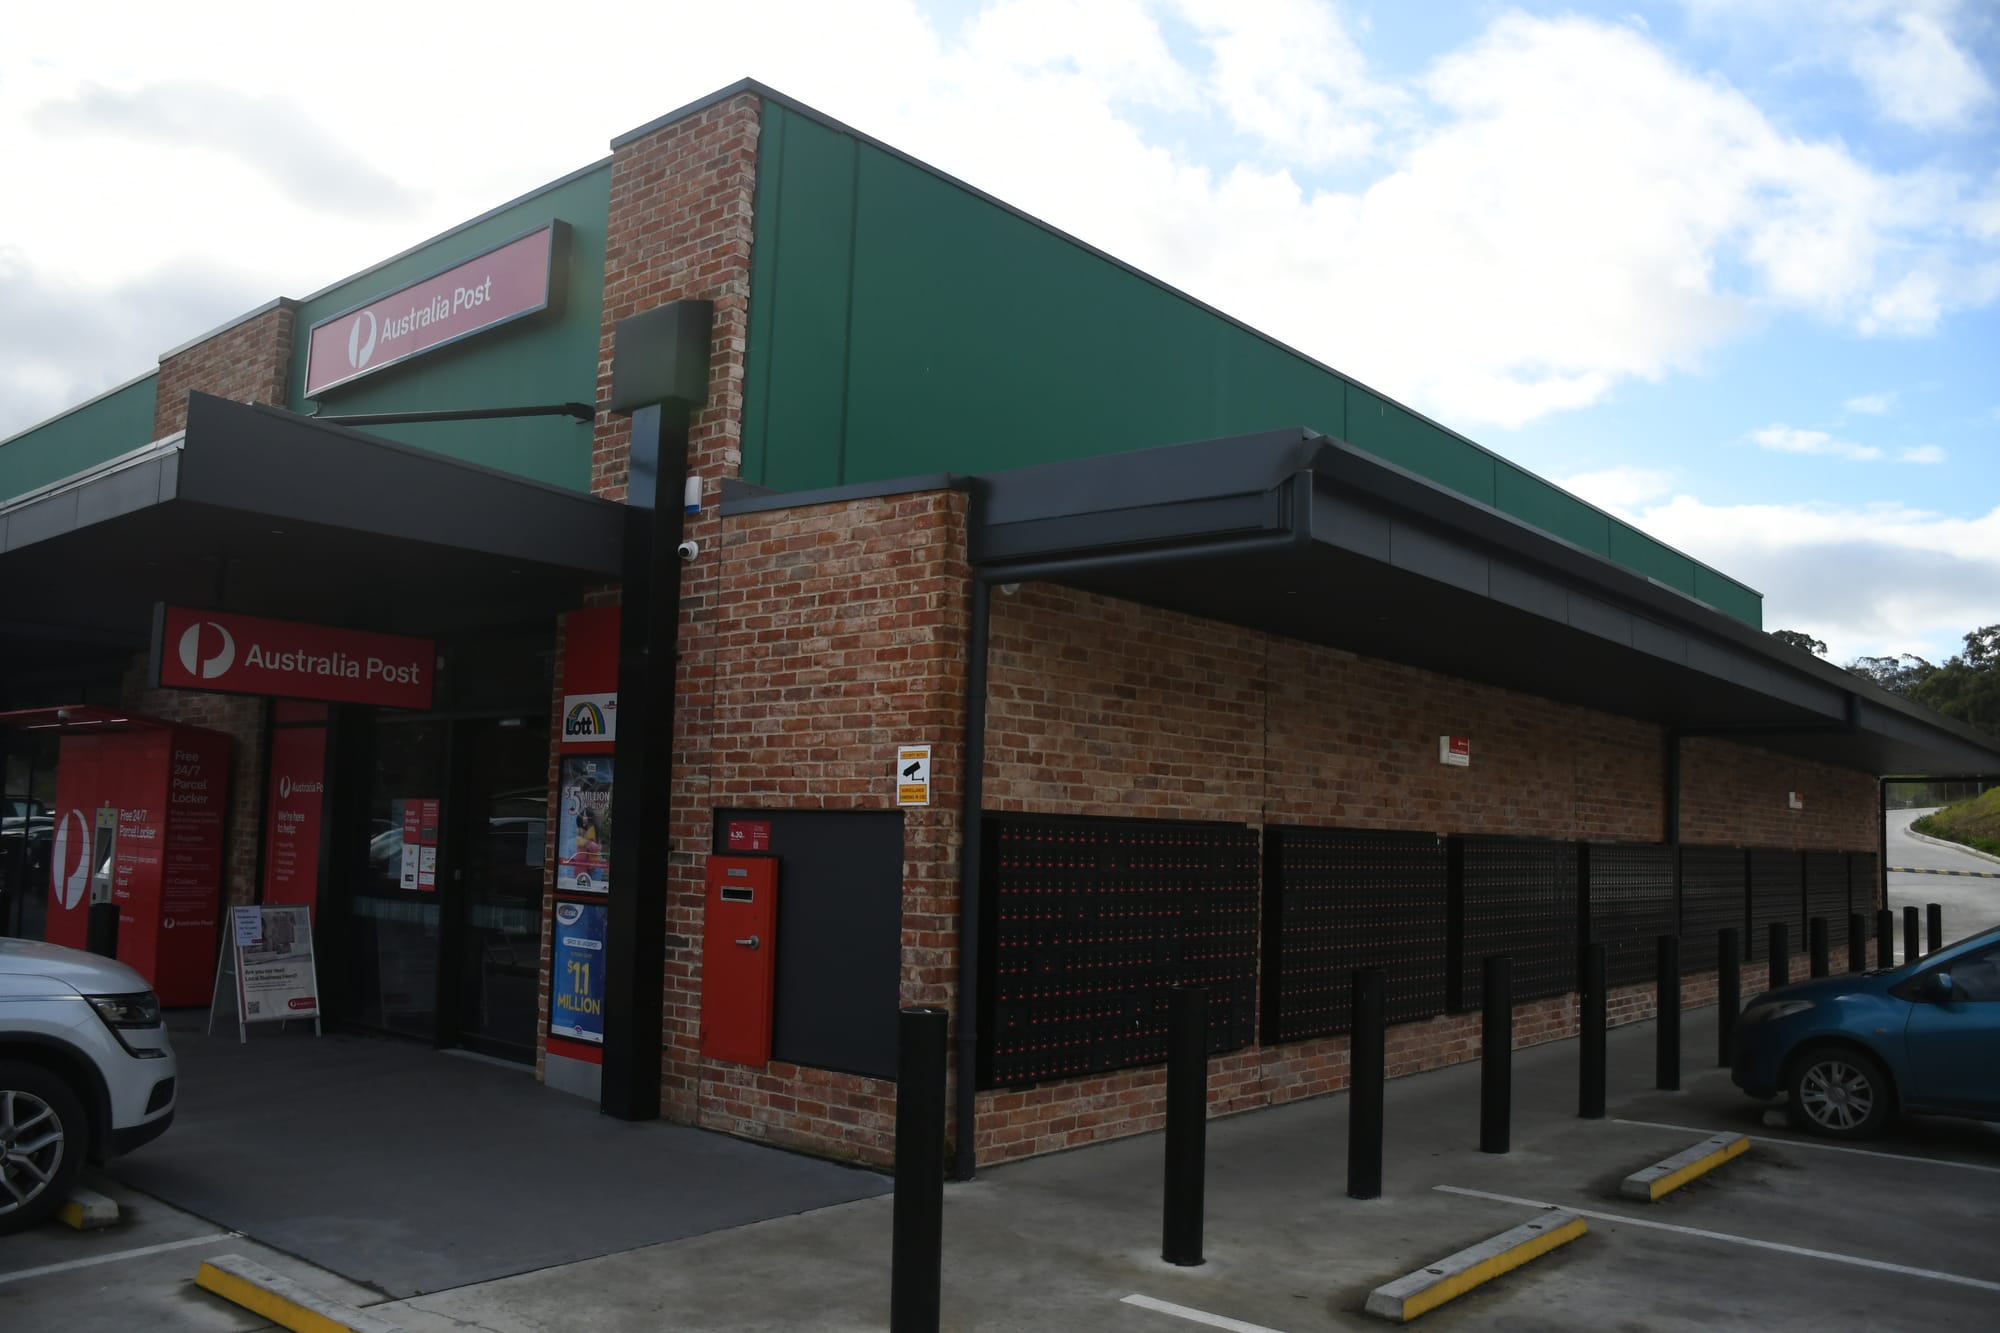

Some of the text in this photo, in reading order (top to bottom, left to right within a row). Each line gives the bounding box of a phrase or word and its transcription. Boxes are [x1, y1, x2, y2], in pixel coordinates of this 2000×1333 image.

[381, 275, 491, 343] Australia Post
[244, 643, 420, 684] Australia Post
[566, 717, 592, 735] Lott
[175, 751, 199, 761] Free
[174, 765, 200, 777] 24/7
[173, 778, 208, 790] Parcel
[291, 782, 316, 792] Australia
[171, 792, 208, 804] Locker
[565, 785, 610, 814] $5 MILLION
[120, 809, 147, 821] Free 24/7
[119, 825, 156, 839] Parcel Locker
[567, 960, 590, 995] $1.1
[557, 993, 601, 1015] MILLION
